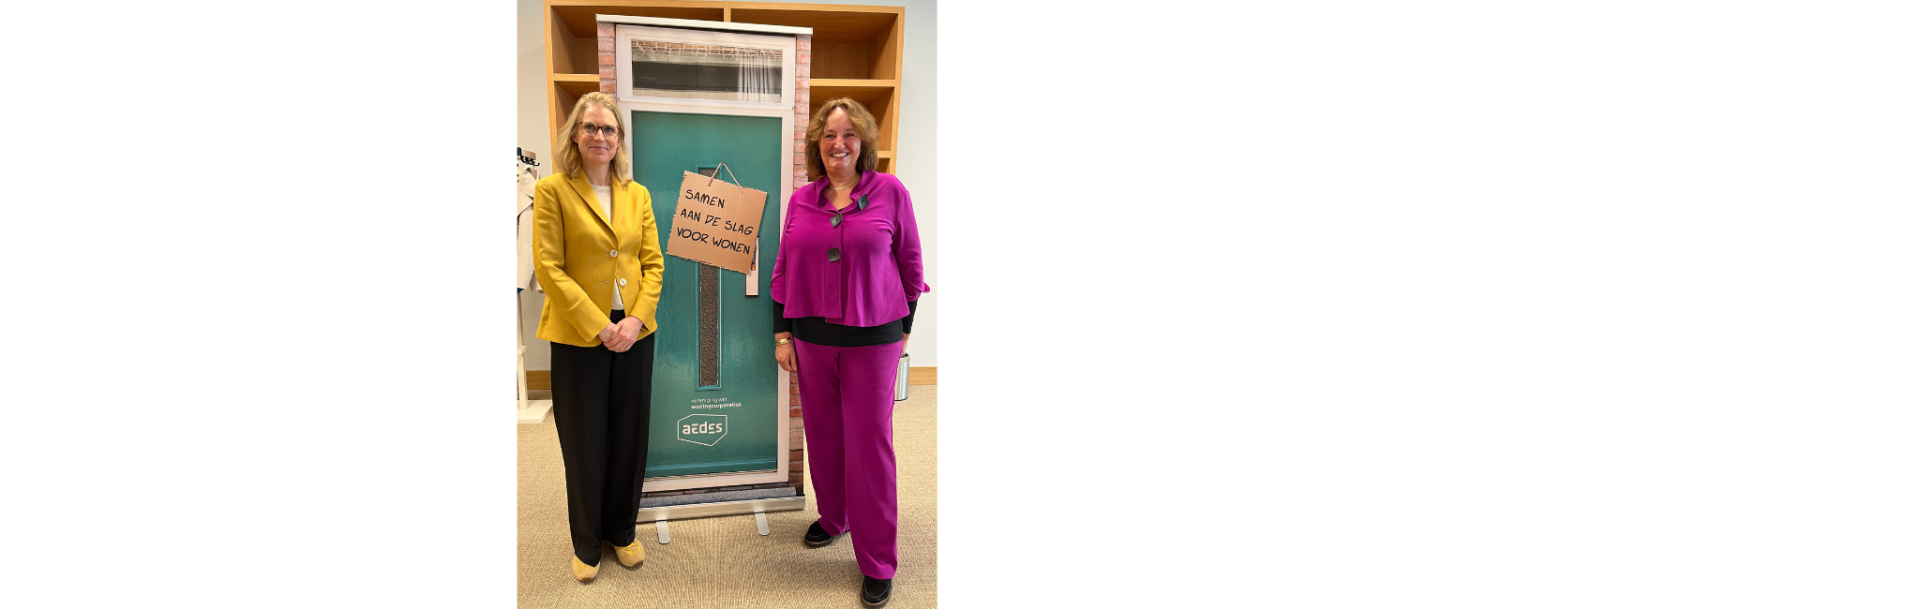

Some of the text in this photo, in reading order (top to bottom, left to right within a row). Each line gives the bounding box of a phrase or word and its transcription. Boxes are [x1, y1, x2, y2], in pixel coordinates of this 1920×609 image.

[685, 189, 725, 209] SAMEN
[680, 208, 754, 235] AAN DE SLAG
[677, 226, 751, 255] VOOR WONEN
[691, 402, 742, 410] woningcorporaties
